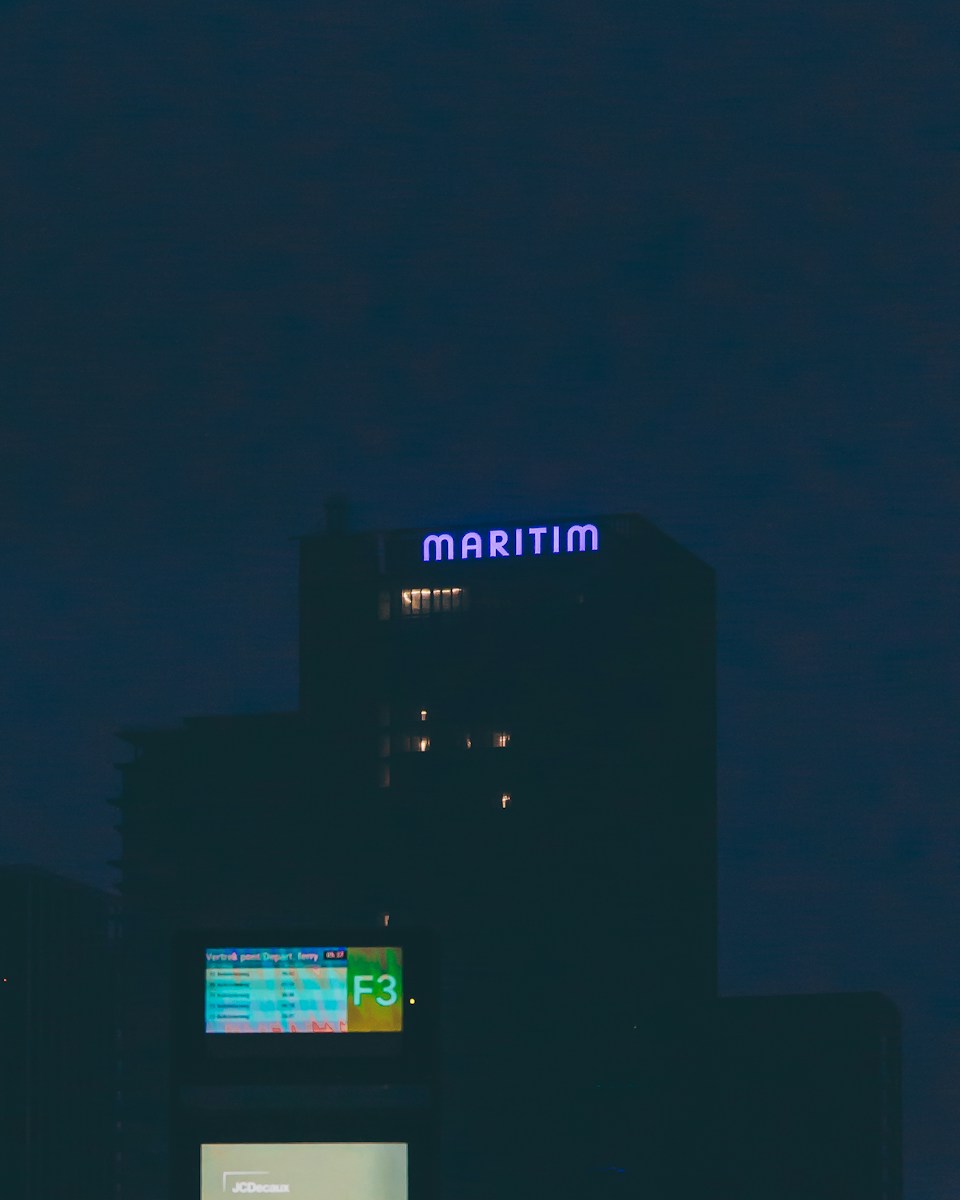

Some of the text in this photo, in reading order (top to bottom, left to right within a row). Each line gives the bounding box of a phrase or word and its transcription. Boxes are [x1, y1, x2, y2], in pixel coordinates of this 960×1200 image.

[423, 523, 599, 562] MARITIM
[352, 974, 398, 1008] F3
[231, 1181, 291, 1194] JCDecaux
